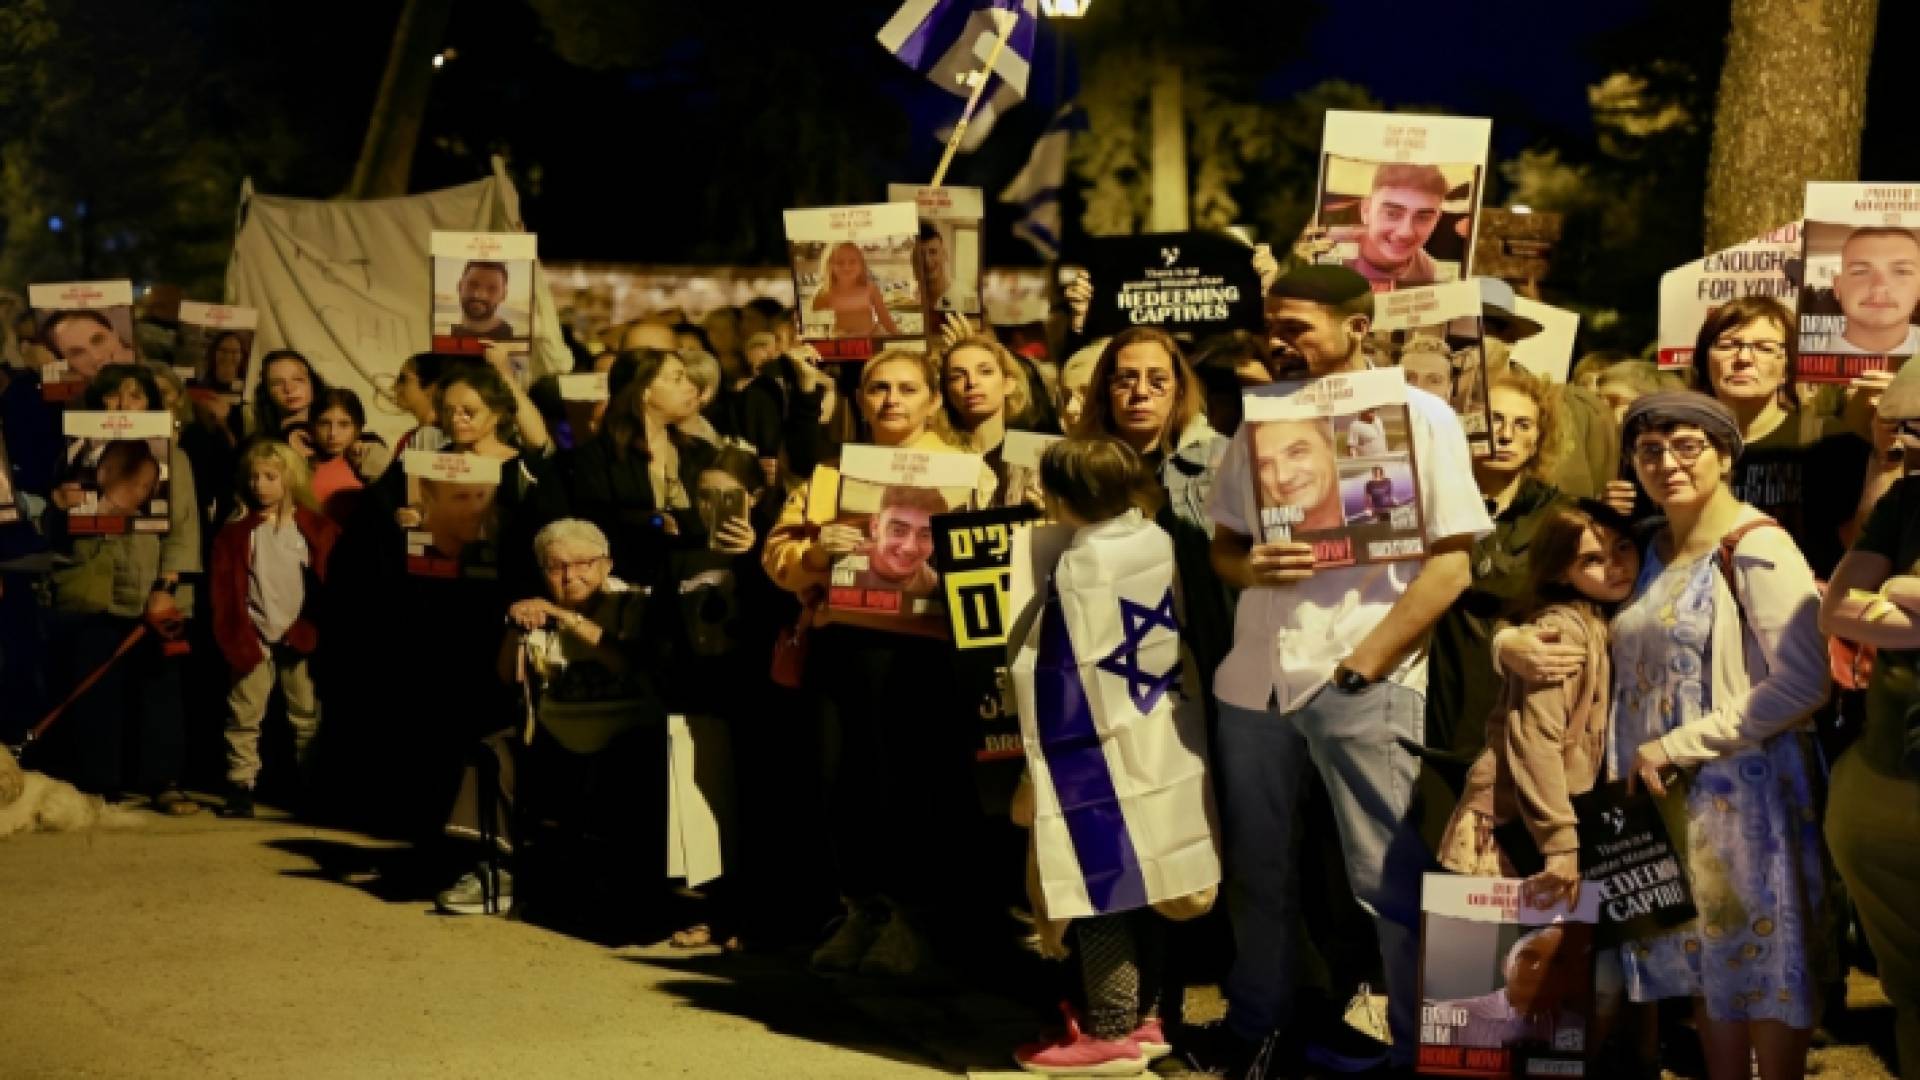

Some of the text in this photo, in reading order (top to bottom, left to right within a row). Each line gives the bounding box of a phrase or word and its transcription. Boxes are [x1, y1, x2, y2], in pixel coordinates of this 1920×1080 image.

[1703, 250, 1786, 274] ENOUGH
[1117, 286, 1240, 309] REDEEMING
[1698, 278, 1797, 300] FOR YOUR
[1130, 304, 1229, 323] CAPTIVES
[1800, 315, 1847, 336] BRING
